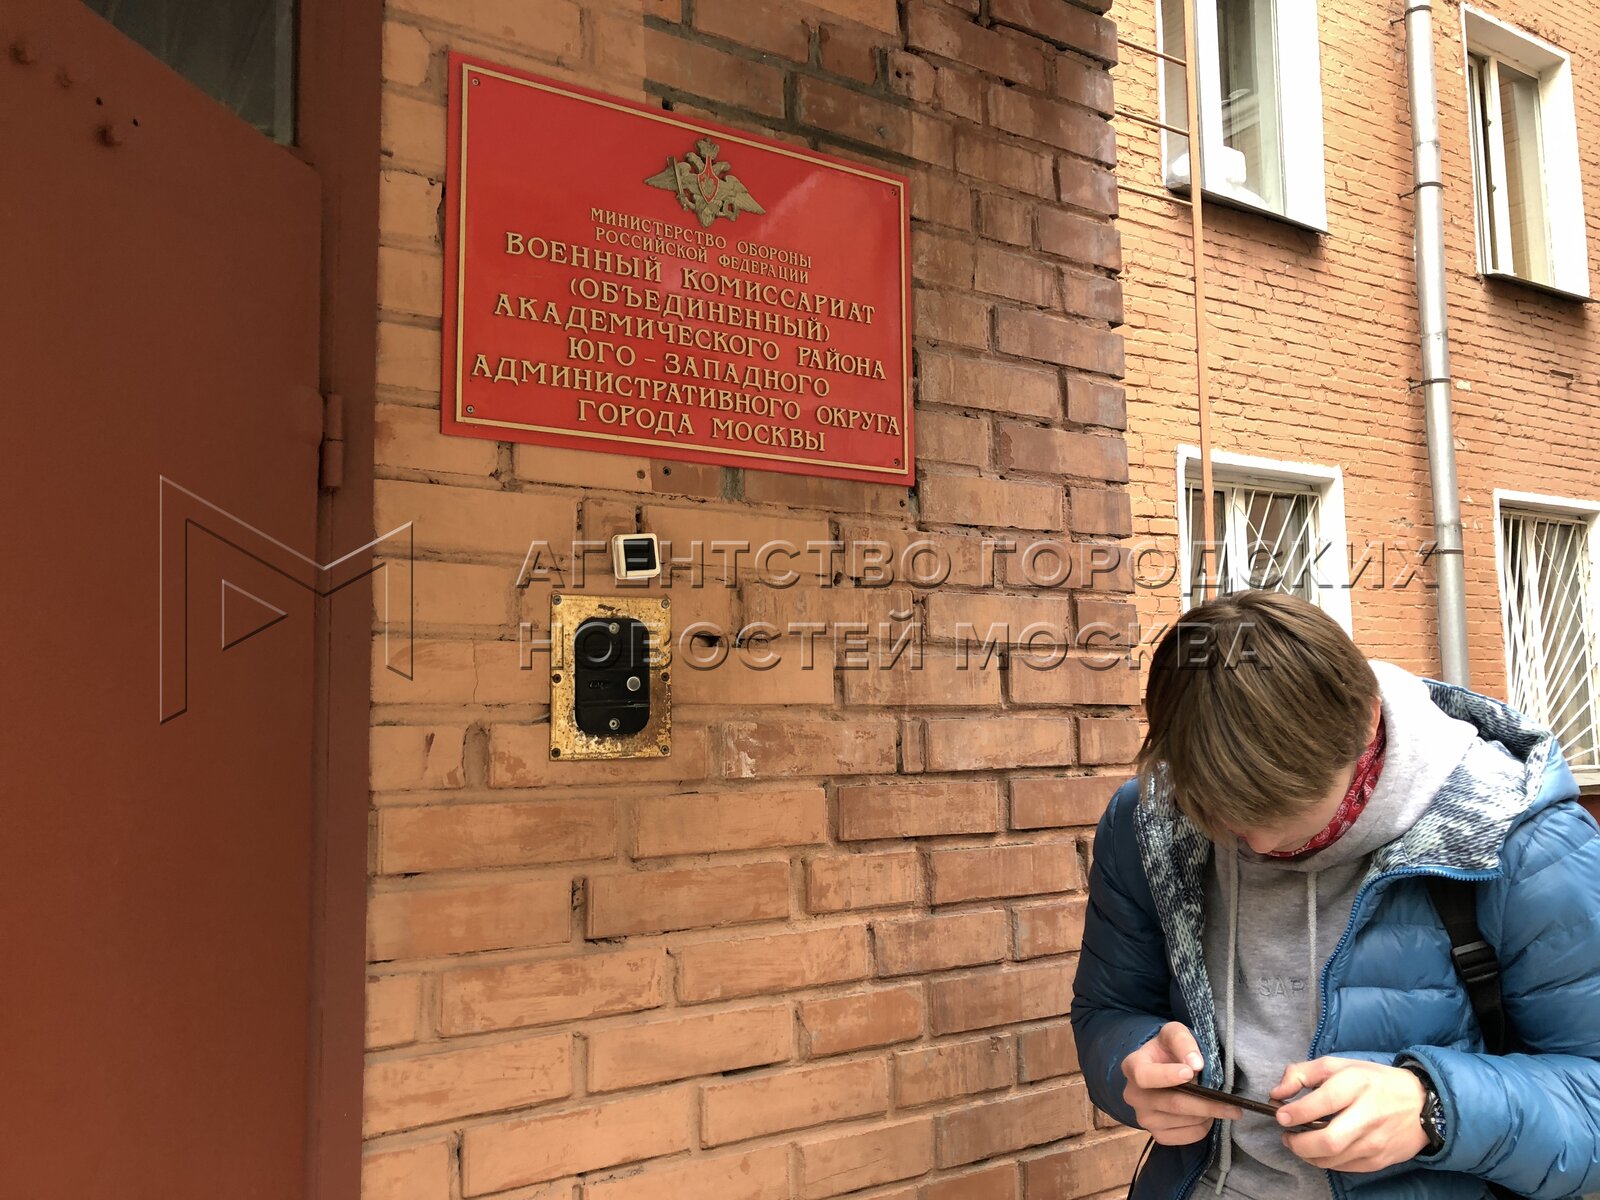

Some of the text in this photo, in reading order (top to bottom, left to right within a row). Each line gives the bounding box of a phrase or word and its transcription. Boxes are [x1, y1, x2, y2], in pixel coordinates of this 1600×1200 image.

[590, 207, 812, 269] МИНИСТЕРСТВО ОБОРОНЫ
[595, 226, 809, 285] РОССИЙСКОЙ ФЕДЕРАЦИИ
[505, 231, 875, 325] ВОЕННЫЙ КОМИССАРИАТ
[569, 276, 831, 343] (ОБЪЕДИНЕННЫЙ)
[493, 293, 886, 380] АКАДЕМИЧЕСКОГО РАЙОНА
[568, 336, 636, 367] ЮГО
[664, 352, 830, 398] ЗАПАДНОГО
[471, 353, 900, 437] АДМИНИСТРАТИВНОГО ОКРУГА
[578, 398, 826, 452] ГОРОДА МОСКВЫ
